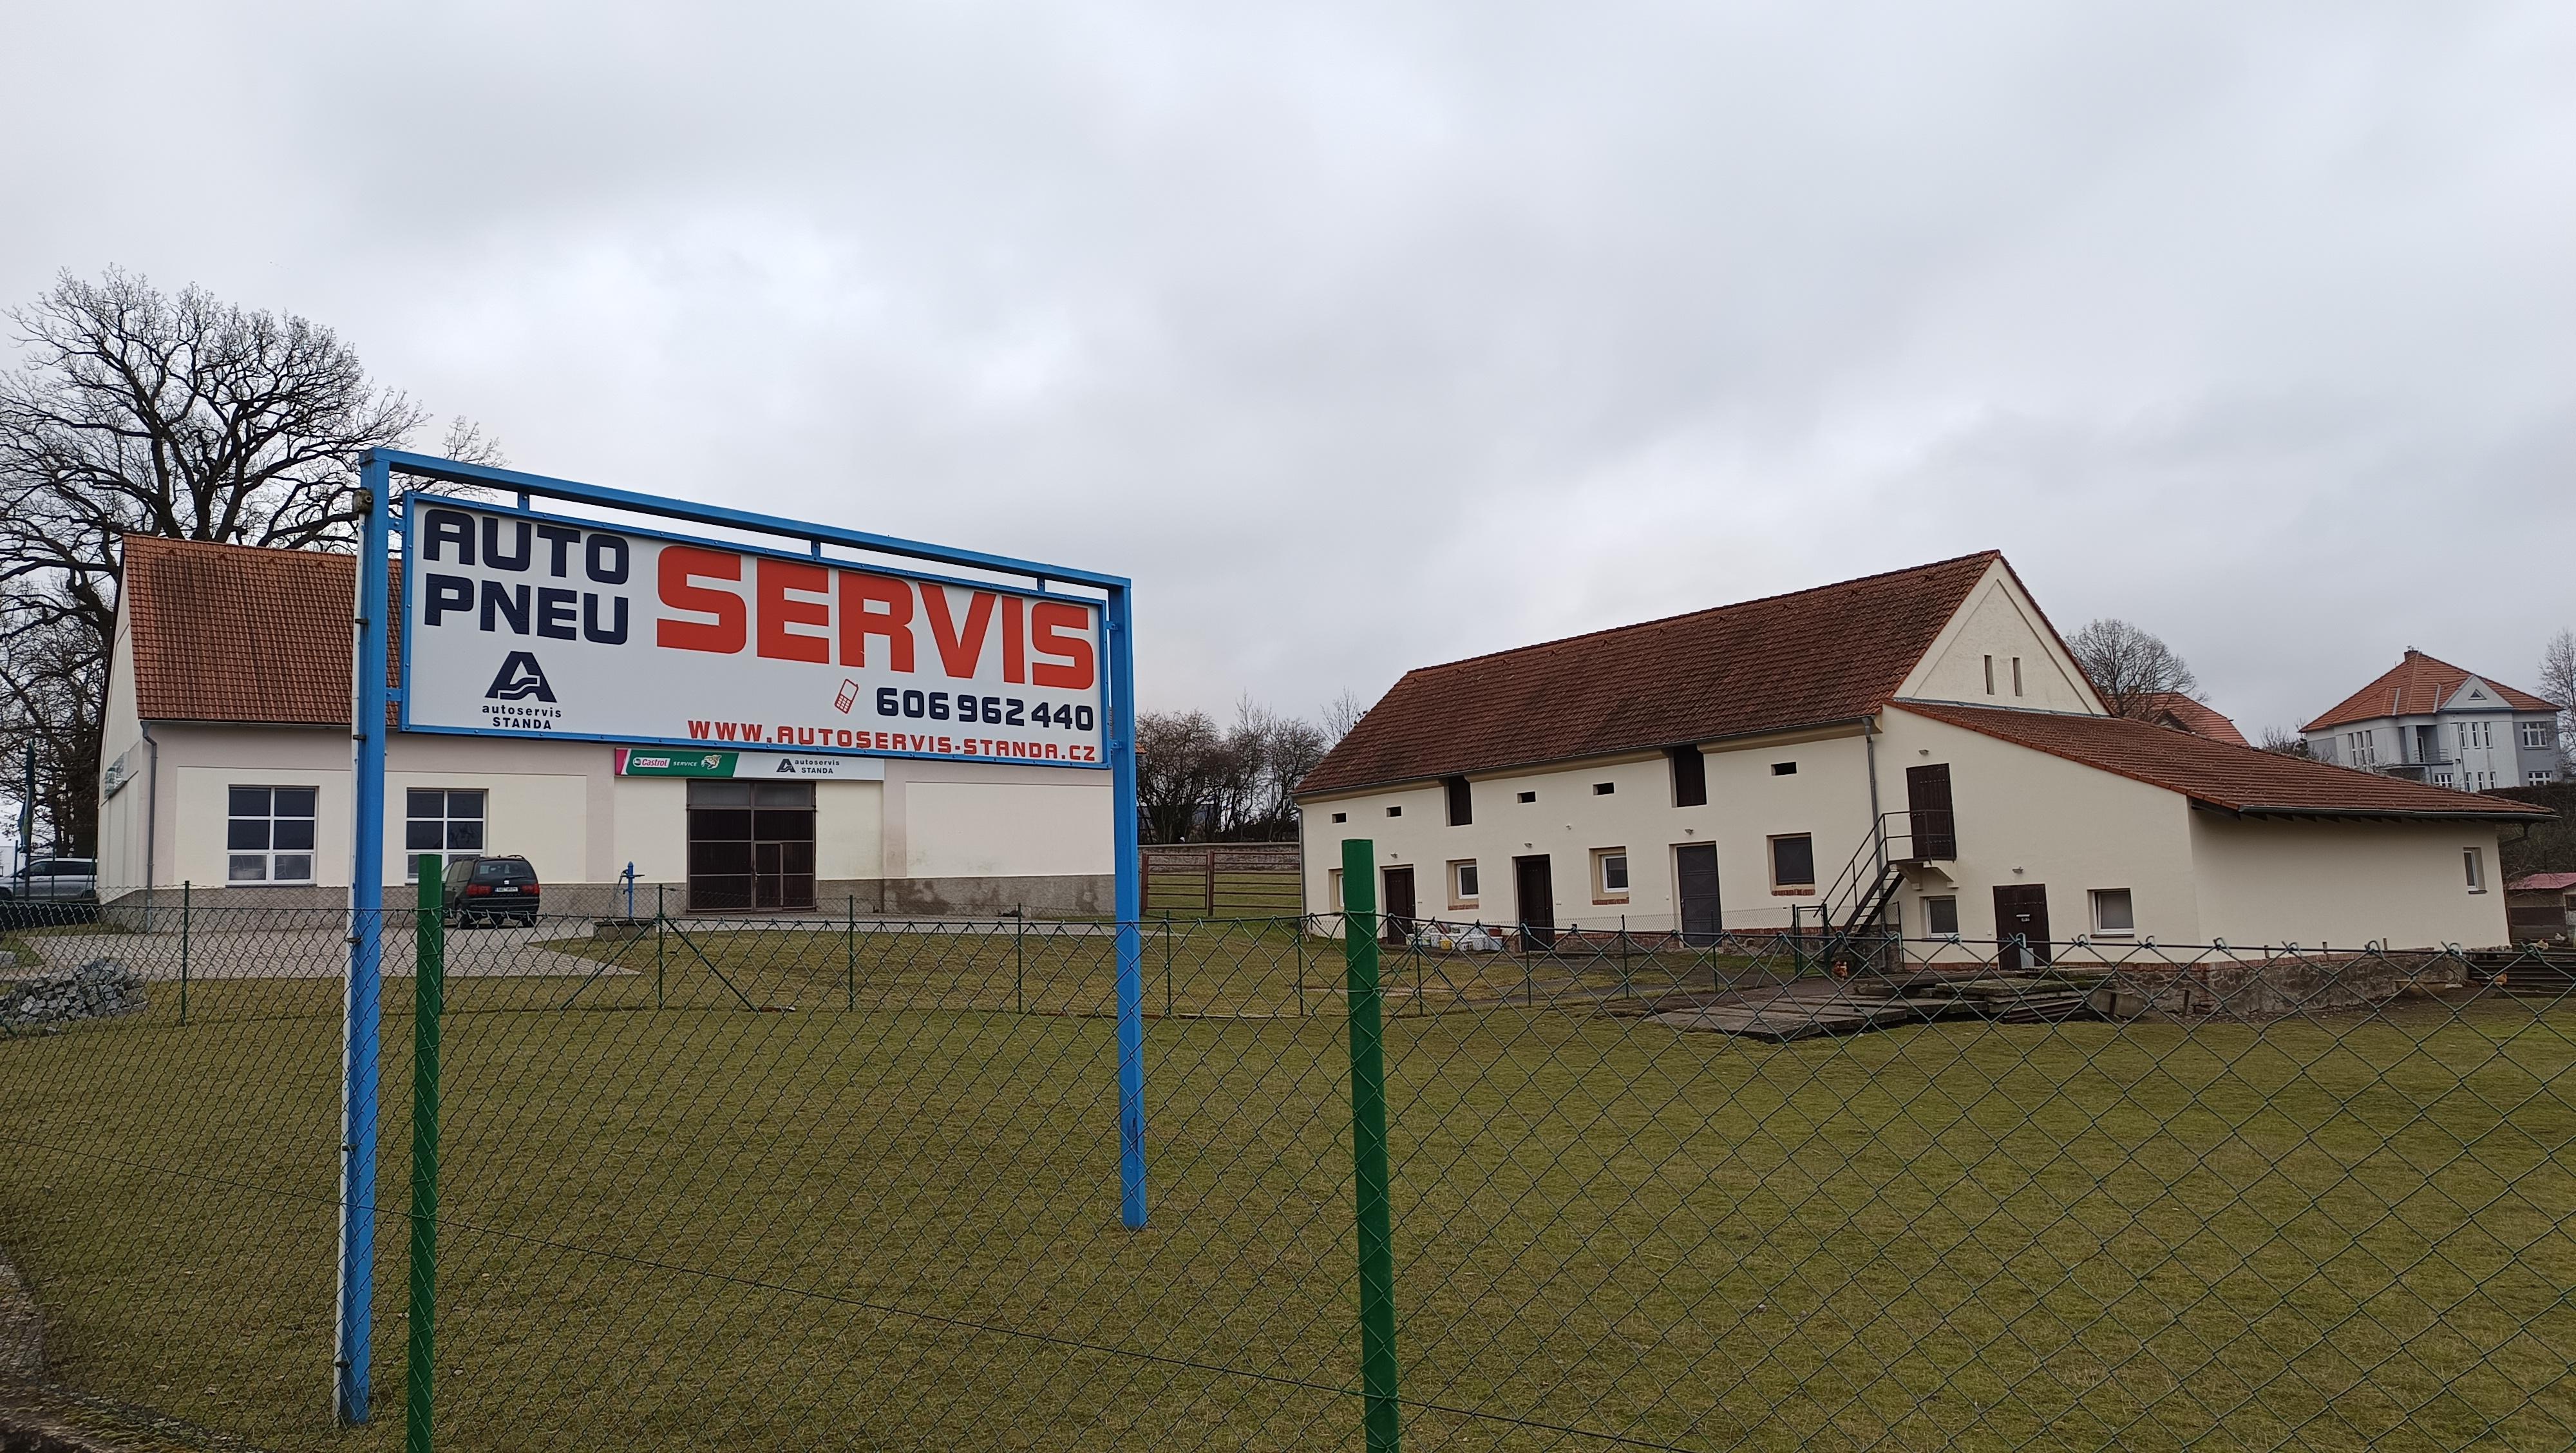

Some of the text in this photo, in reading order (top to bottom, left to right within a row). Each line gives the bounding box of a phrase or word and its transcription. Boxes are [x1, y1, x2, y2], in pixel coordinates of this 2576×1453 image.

[423, 509, 629, 585] AUTO
[424, 573, 629, 645] PNEU
[657, 546, 1094, 690] SERVIS
[482, 705, 562, 717] autoservis
[493, 717, 551, 730] STANDA
